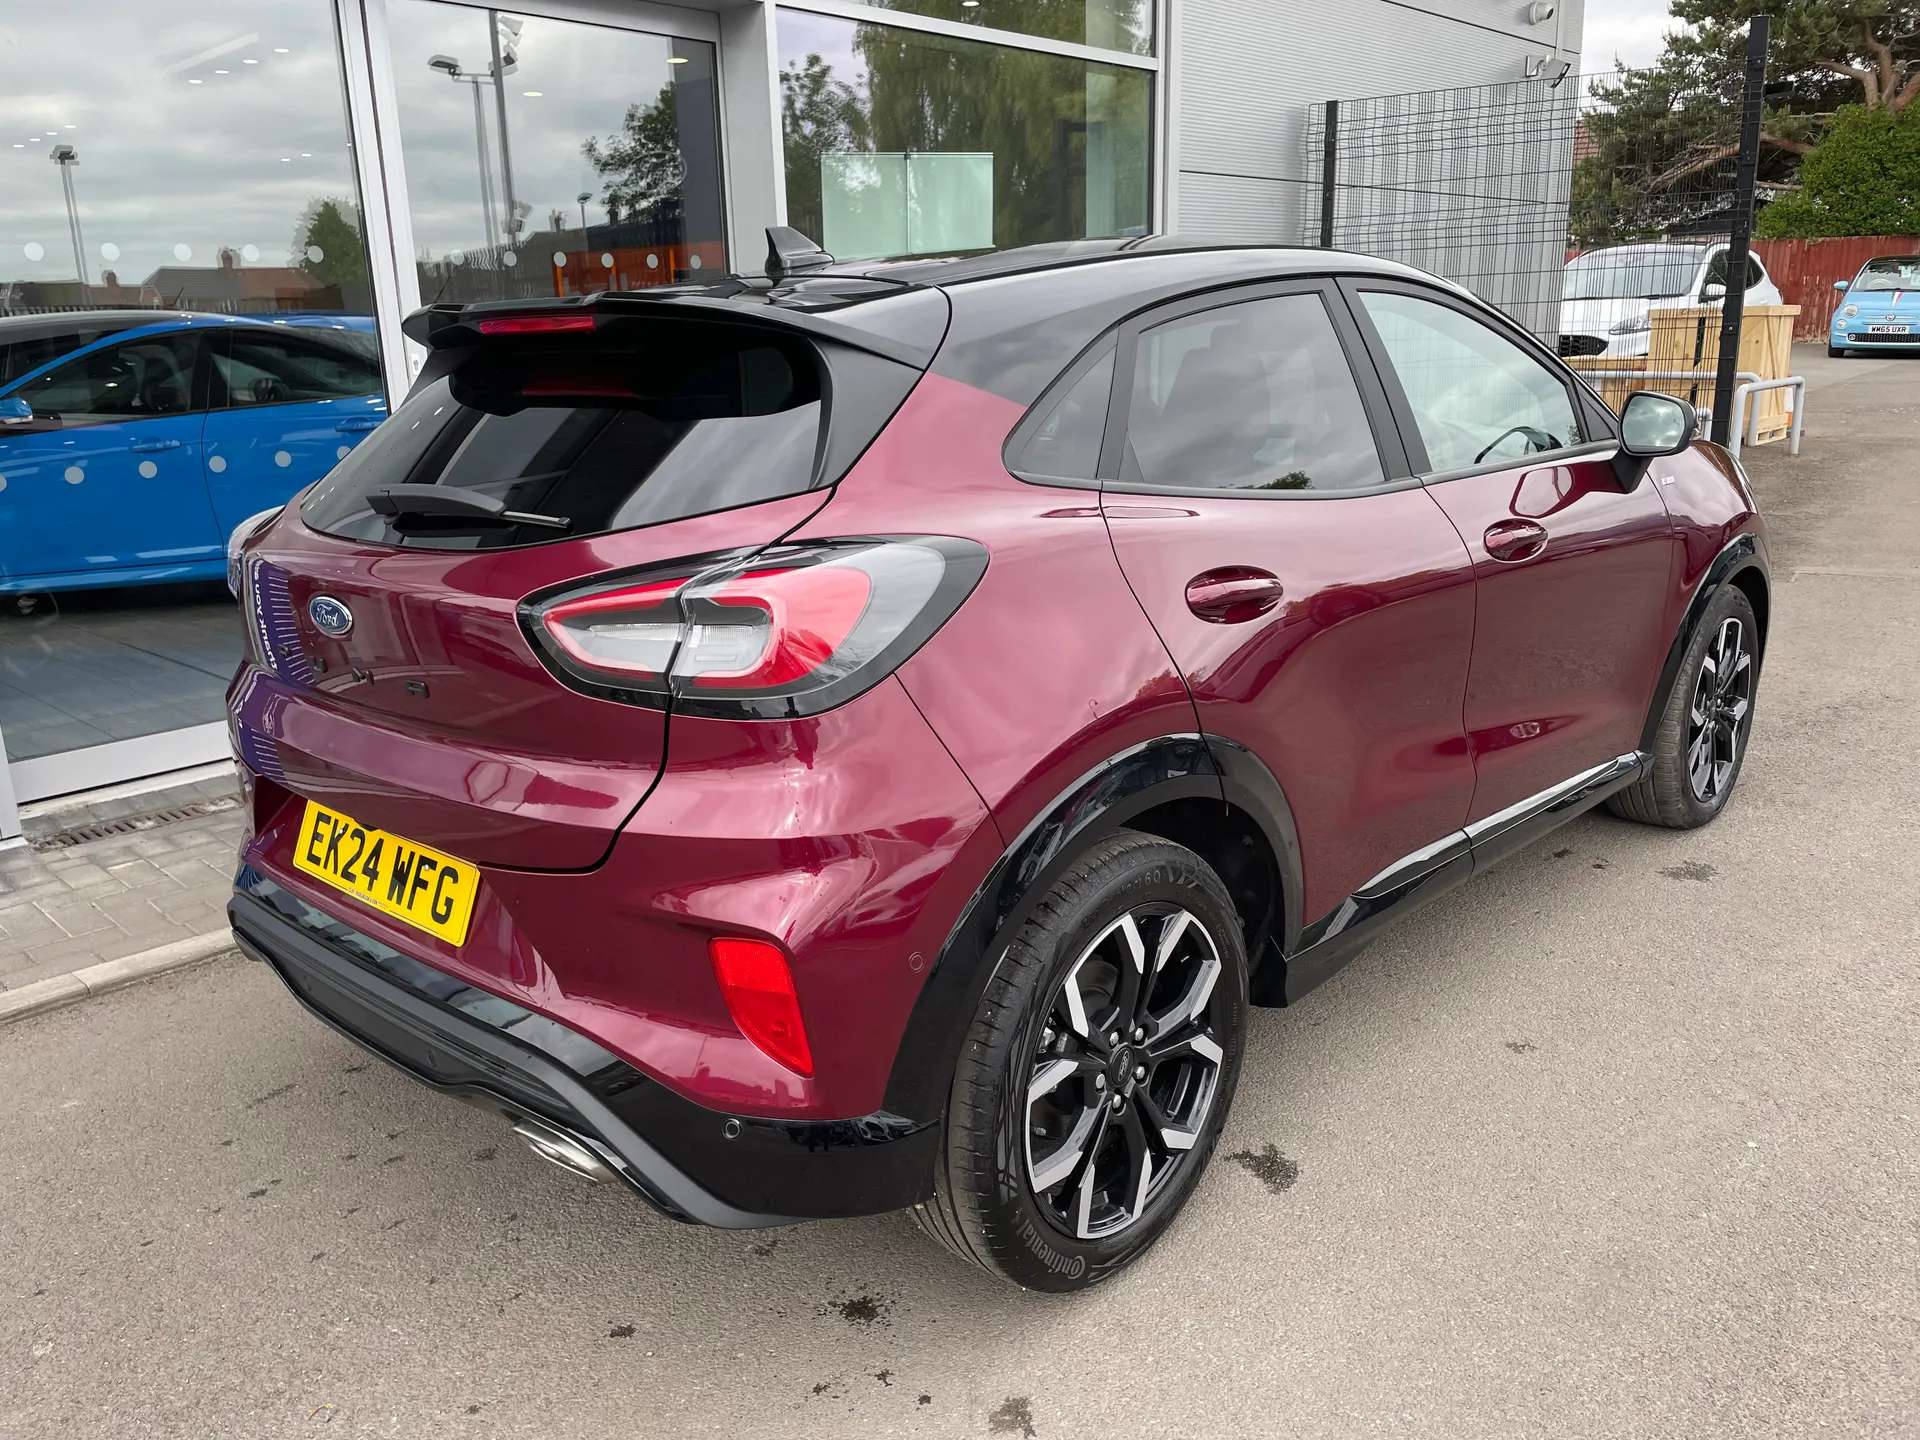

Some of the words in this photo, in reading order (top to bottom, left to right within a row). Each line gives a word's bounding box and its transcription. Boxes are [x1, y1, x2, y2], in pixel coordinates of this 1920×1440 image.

[316, 603, 339, 627] Ford
[306, 811, 385, 892] EK24
[387, 845, 459, 925] WFG
[1016, 1219, 1086, 1280] Continental
